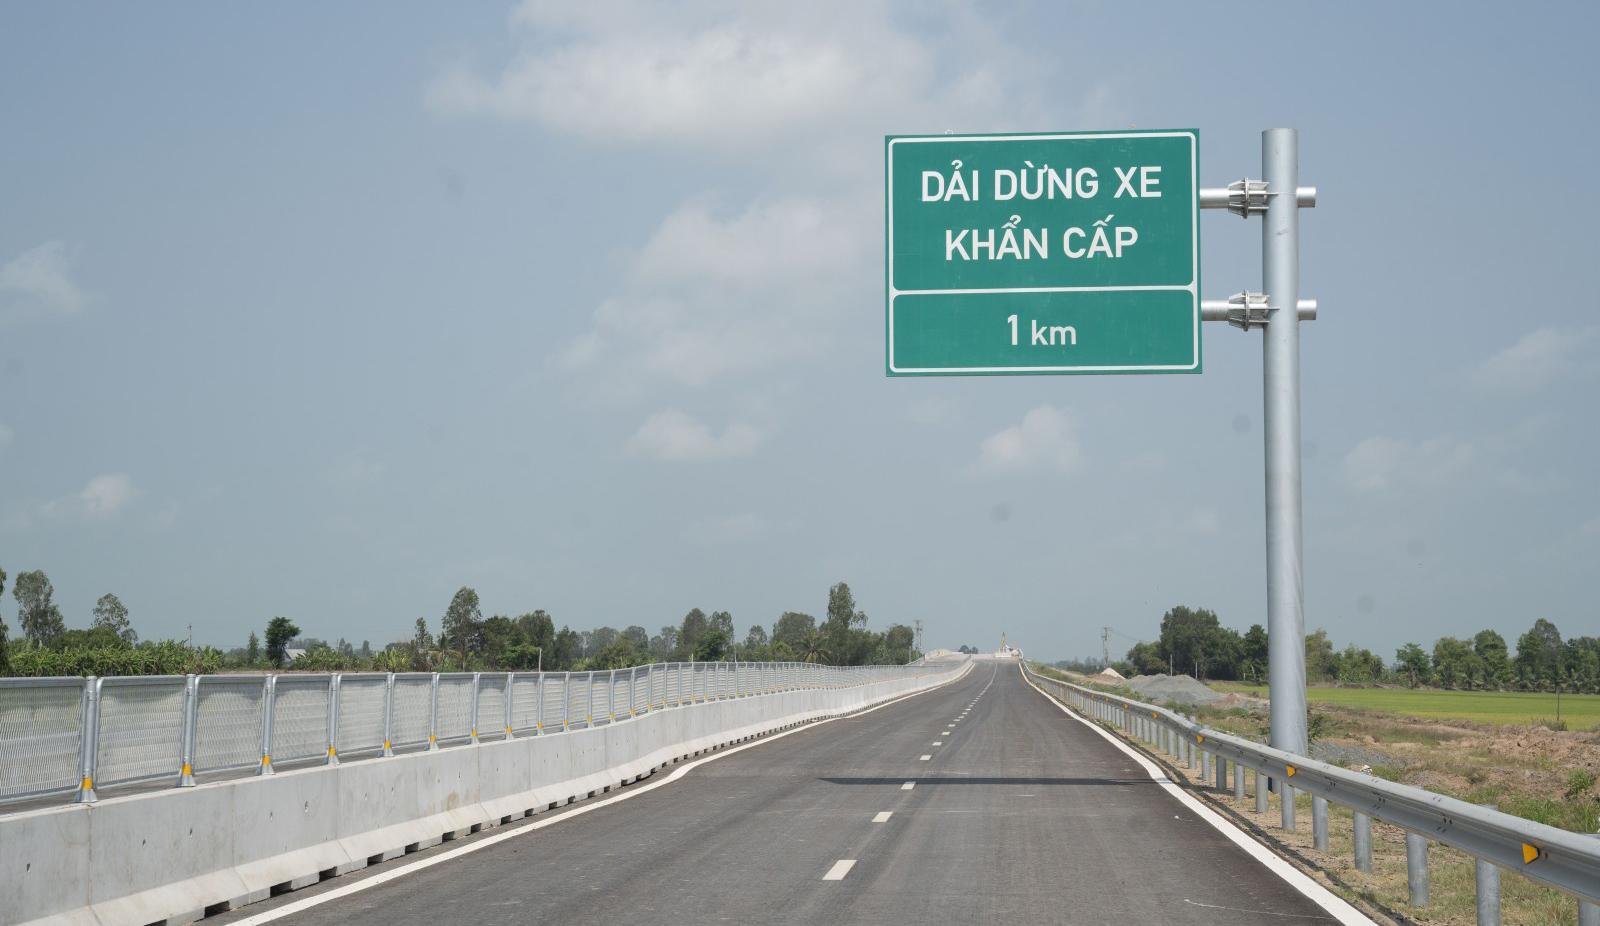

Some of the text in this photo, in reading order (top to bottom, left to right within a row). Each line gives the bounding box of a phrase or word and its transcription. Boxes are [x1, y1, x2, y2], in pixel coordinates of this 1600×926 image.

[921, 159, 1162, 202] DẢI DỪNG XE
[945, 214, 1139, 261] KHẨN CẤP
[1007, 314, 1077, 346] 1 km
